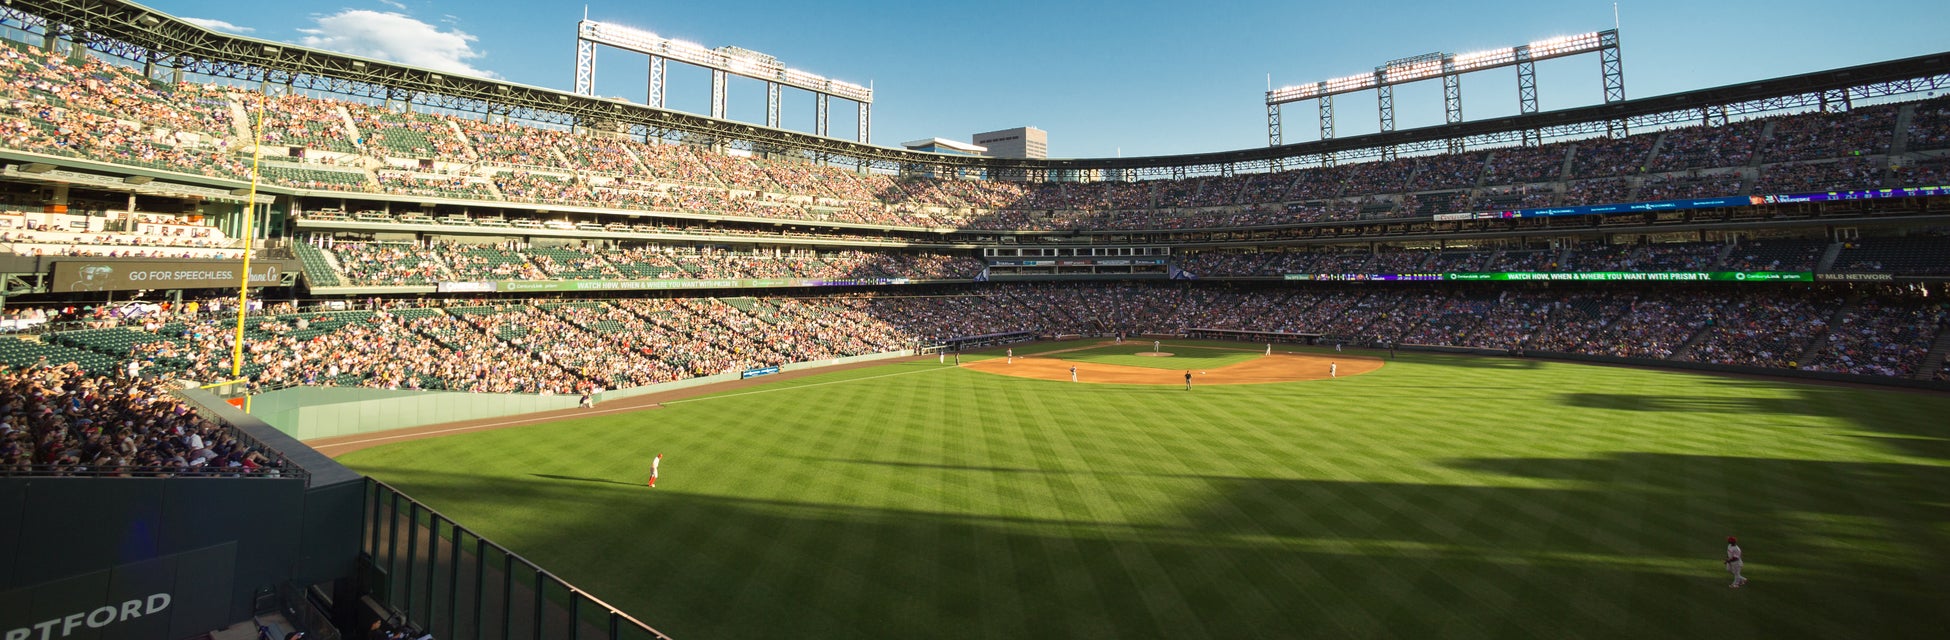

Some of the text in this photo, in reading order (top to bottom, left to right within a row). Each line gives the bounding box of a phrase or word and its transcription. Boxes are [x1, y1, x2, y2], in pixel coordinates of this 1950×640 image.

[129, 270, 234, 281] GO FOR SPEECHLESS.
[247, 266, 267, 282] hane
